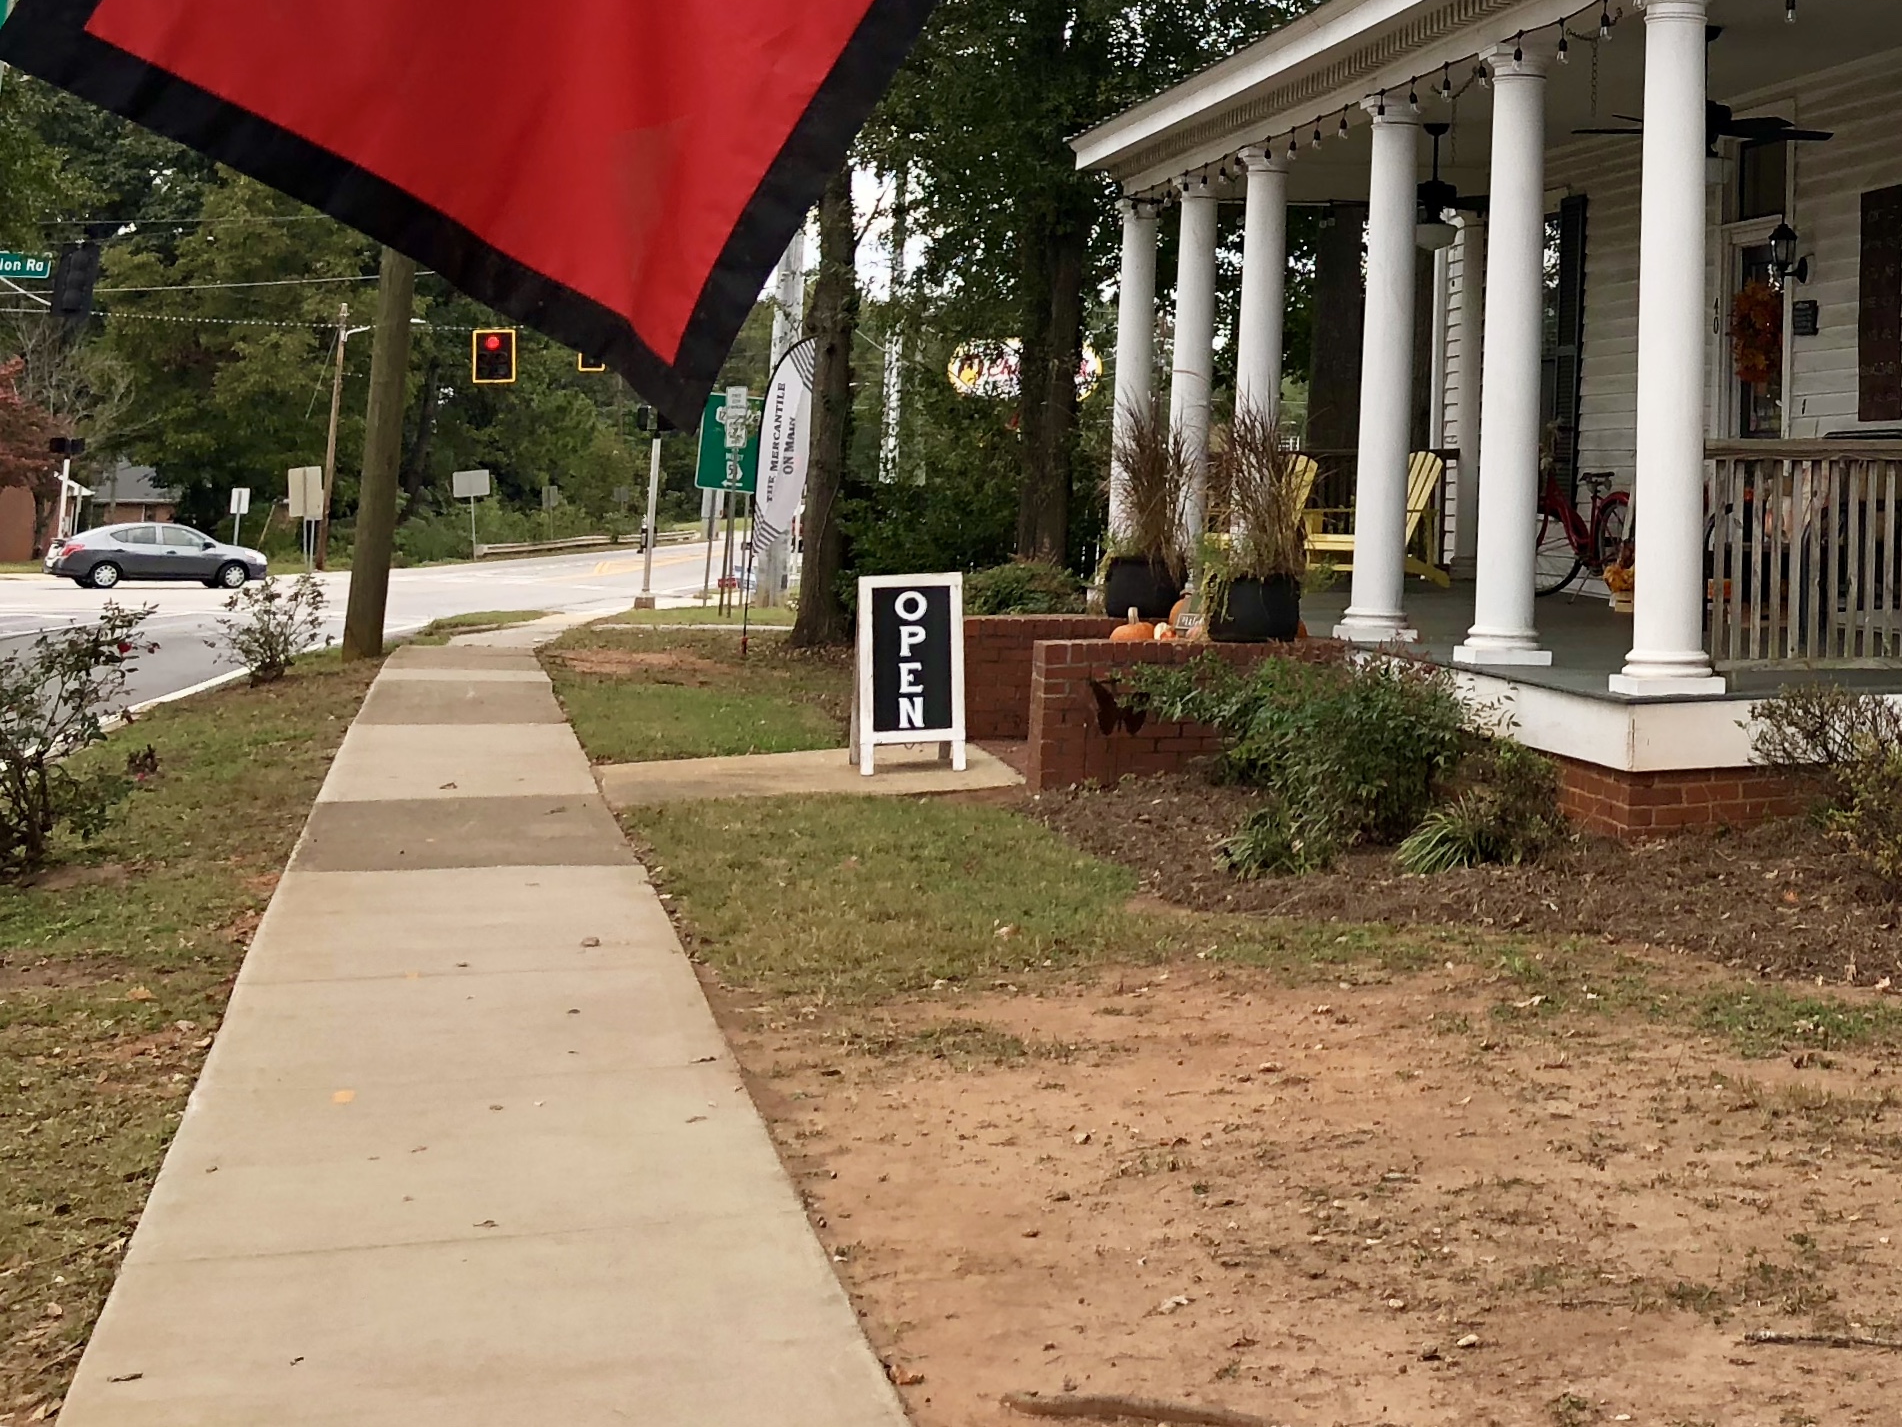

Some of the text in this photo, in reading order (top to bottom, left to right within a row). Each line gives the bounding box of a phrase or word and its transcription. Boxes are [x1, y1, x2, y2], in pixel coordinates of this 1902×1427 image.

[1713, 297, 1719, 334] 40
[766, 382, 786, 503] THE MERCANTILE
[782, 416, 796, 476] ON MAIN
[894, 590, 928, 729] OPEN
